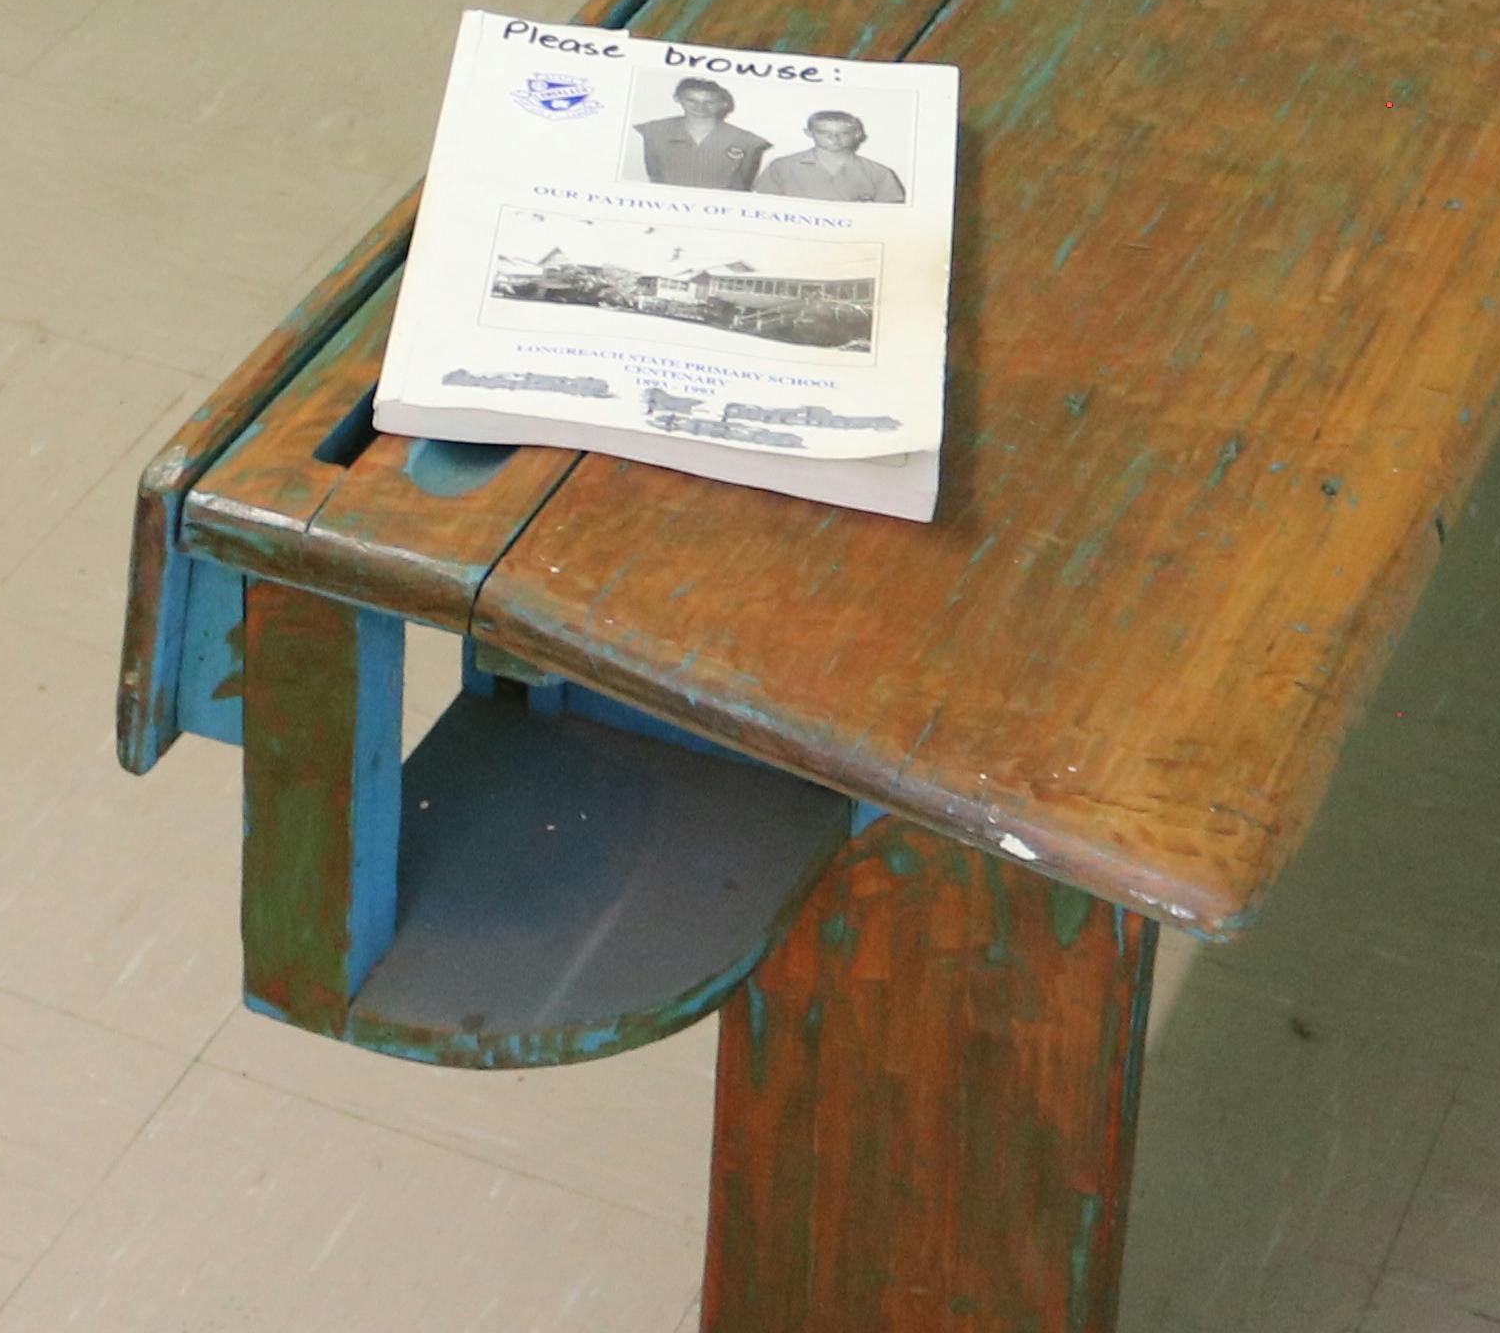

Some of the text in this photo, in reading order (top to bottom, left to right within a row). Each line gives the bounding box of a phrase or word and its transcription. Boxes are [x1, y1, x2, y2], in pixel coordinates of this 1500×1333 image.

[502, 19, 627, 60] Please
[533, 185, 853, 229] OUR PATHWAY OF LEARNING
